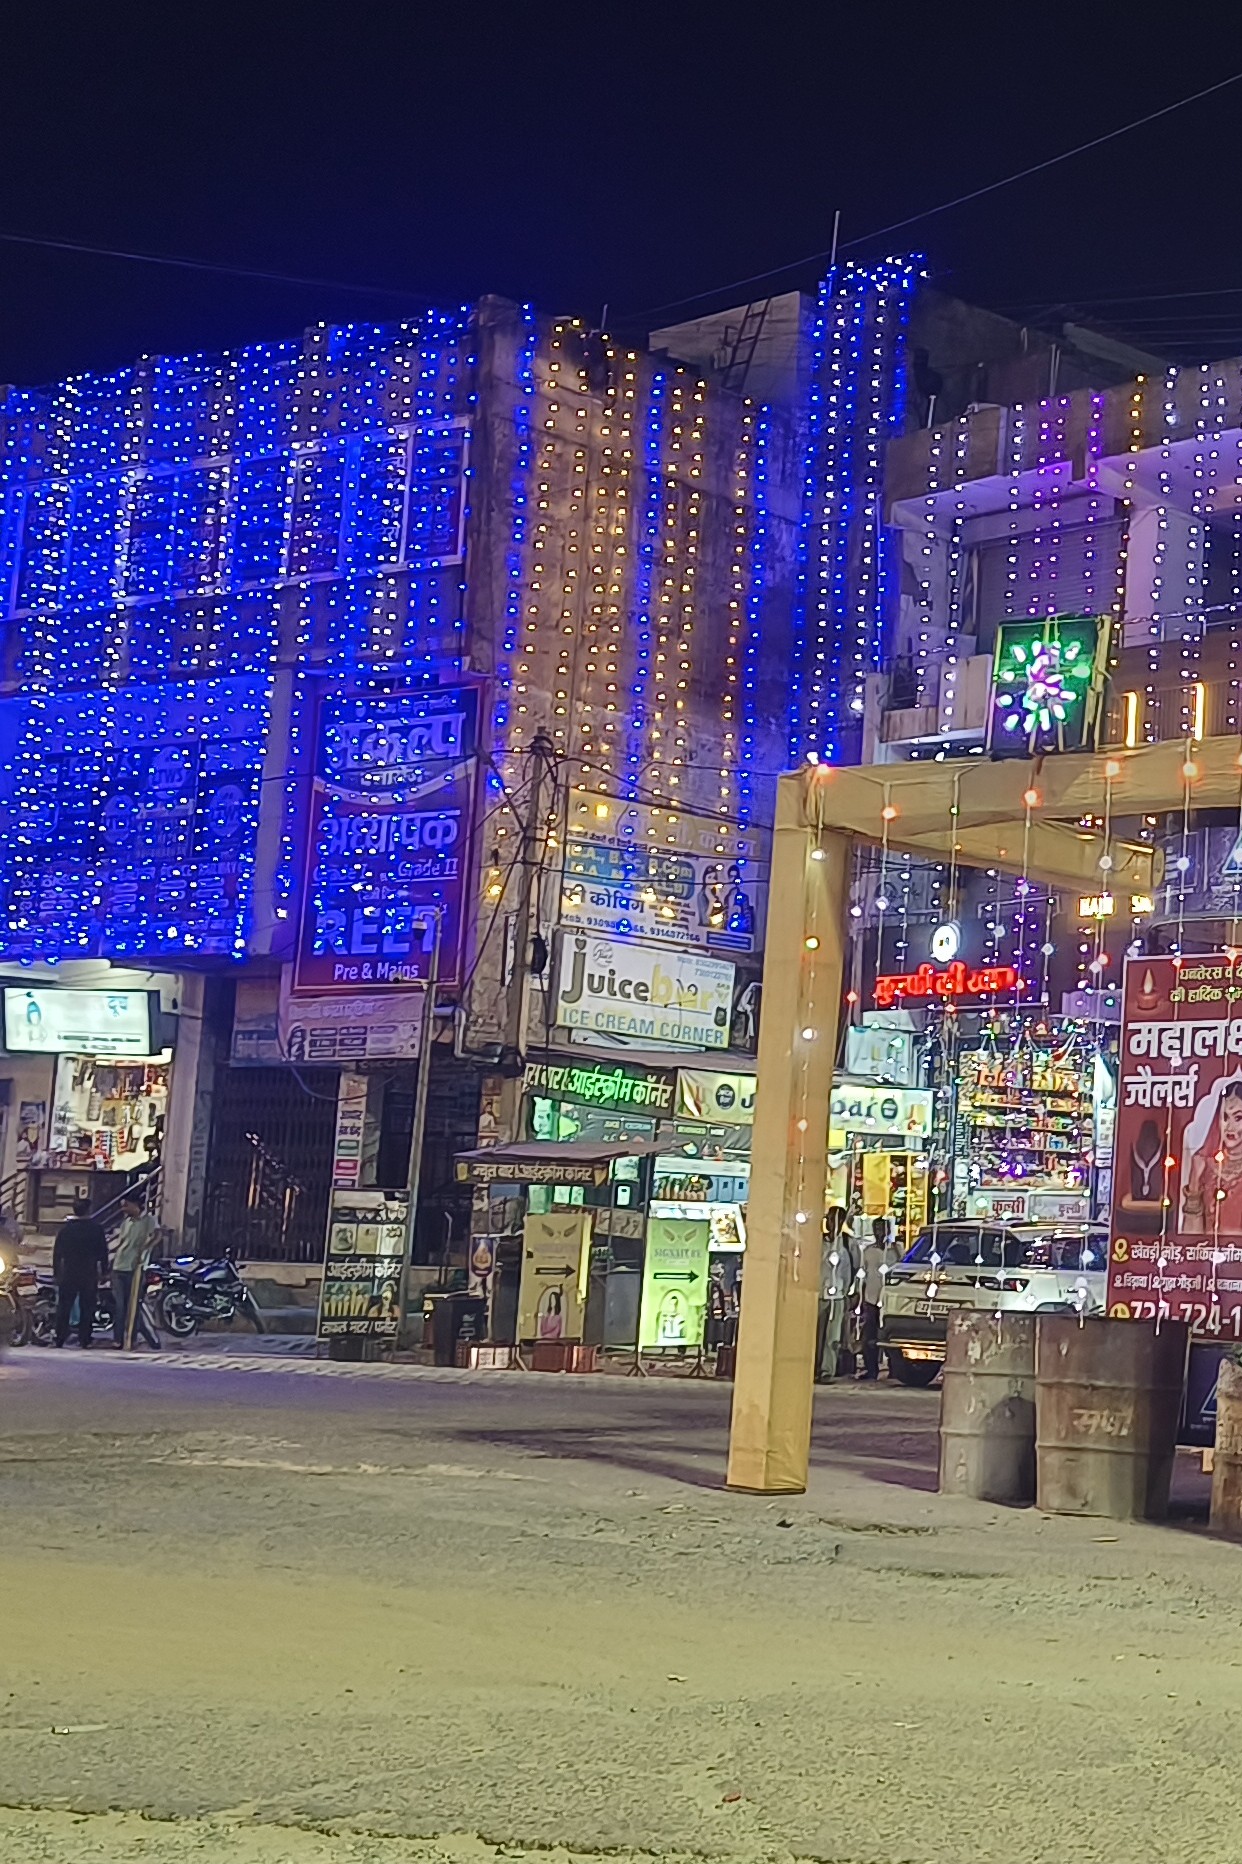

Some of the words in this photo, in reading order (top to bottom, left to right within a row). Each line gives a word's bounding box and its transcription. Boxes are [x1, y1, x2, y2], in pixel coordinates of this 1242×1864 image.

[334, 963, 358, 981] Pre
[361, 962, 373, 980] &
[376, 961, 420, 980] Mains
[562, 1007, 590, 1026] ICE
[594, 1011, 655, 1036] CREAM
[659, 1023, 724, 1045] CORNER
